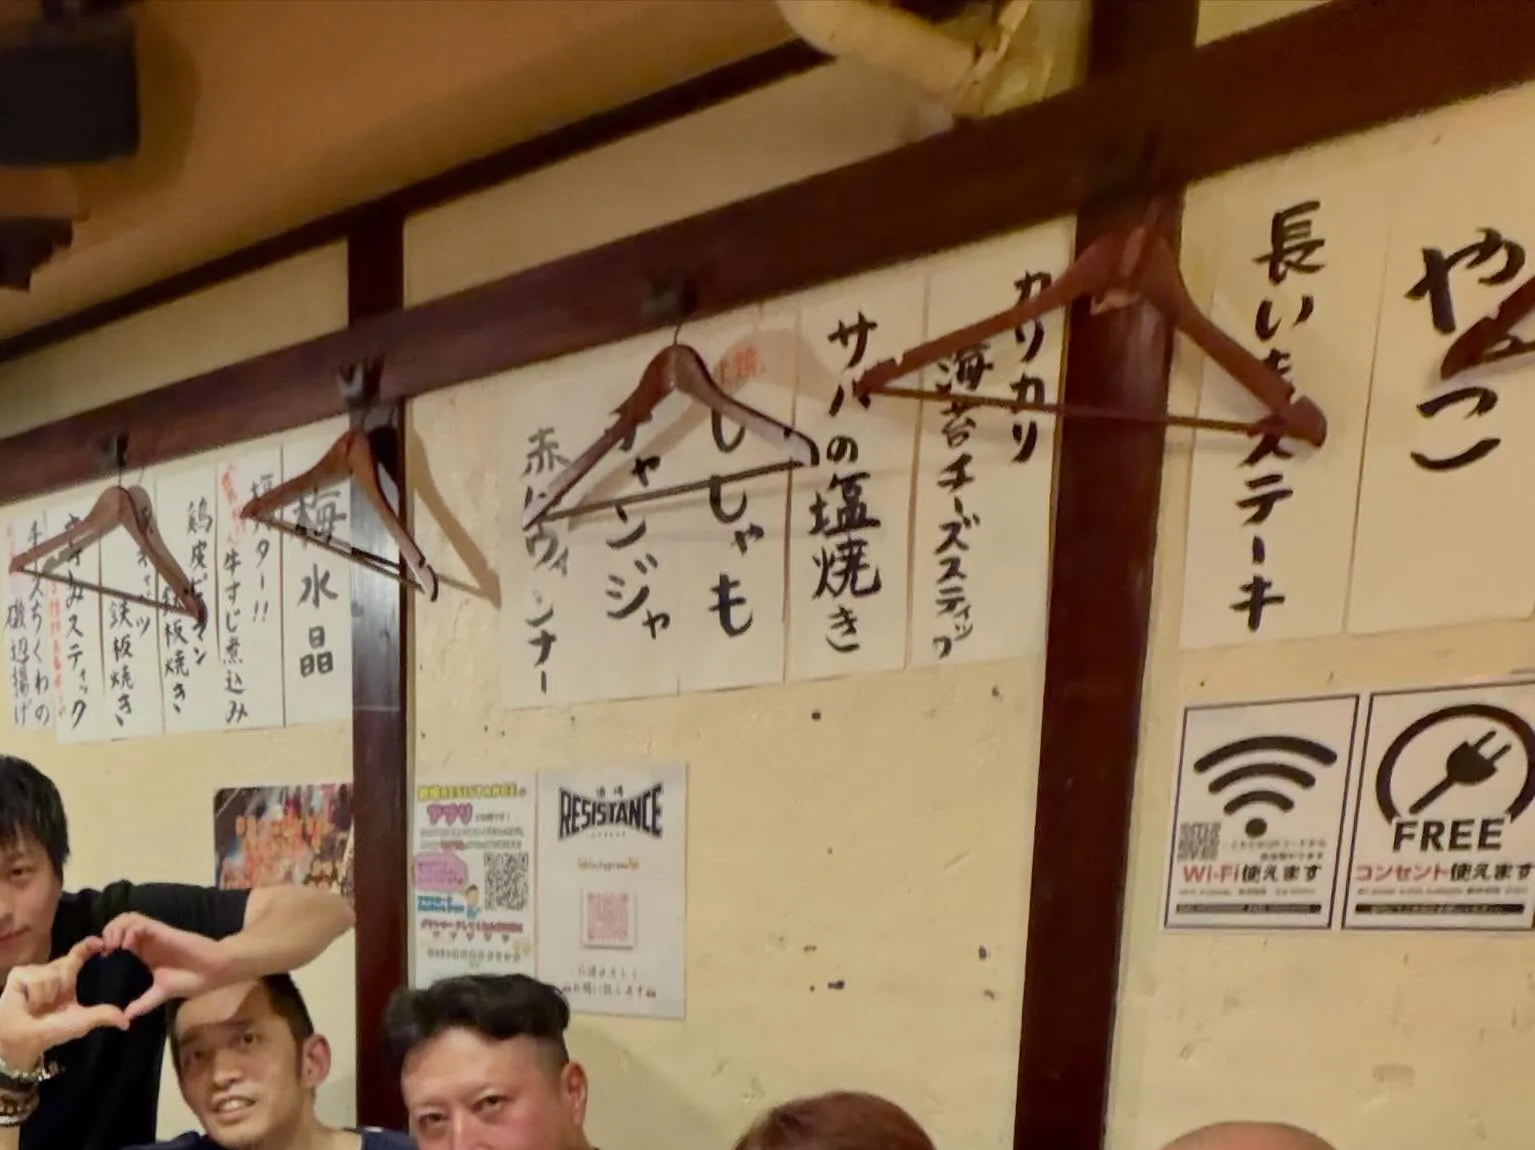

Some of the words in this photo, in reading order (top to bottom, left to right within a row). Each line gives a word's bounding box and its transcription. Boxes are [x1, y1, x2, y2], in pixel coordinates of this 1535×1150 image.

[558, 781, 664, 841] RESISTANCE
[1392, 818, 1505, 853] FREE
[1182, 863, 1322, 884] Wi-Fi使えます
[1355, 861, 1535, 883] コンセント使えます
